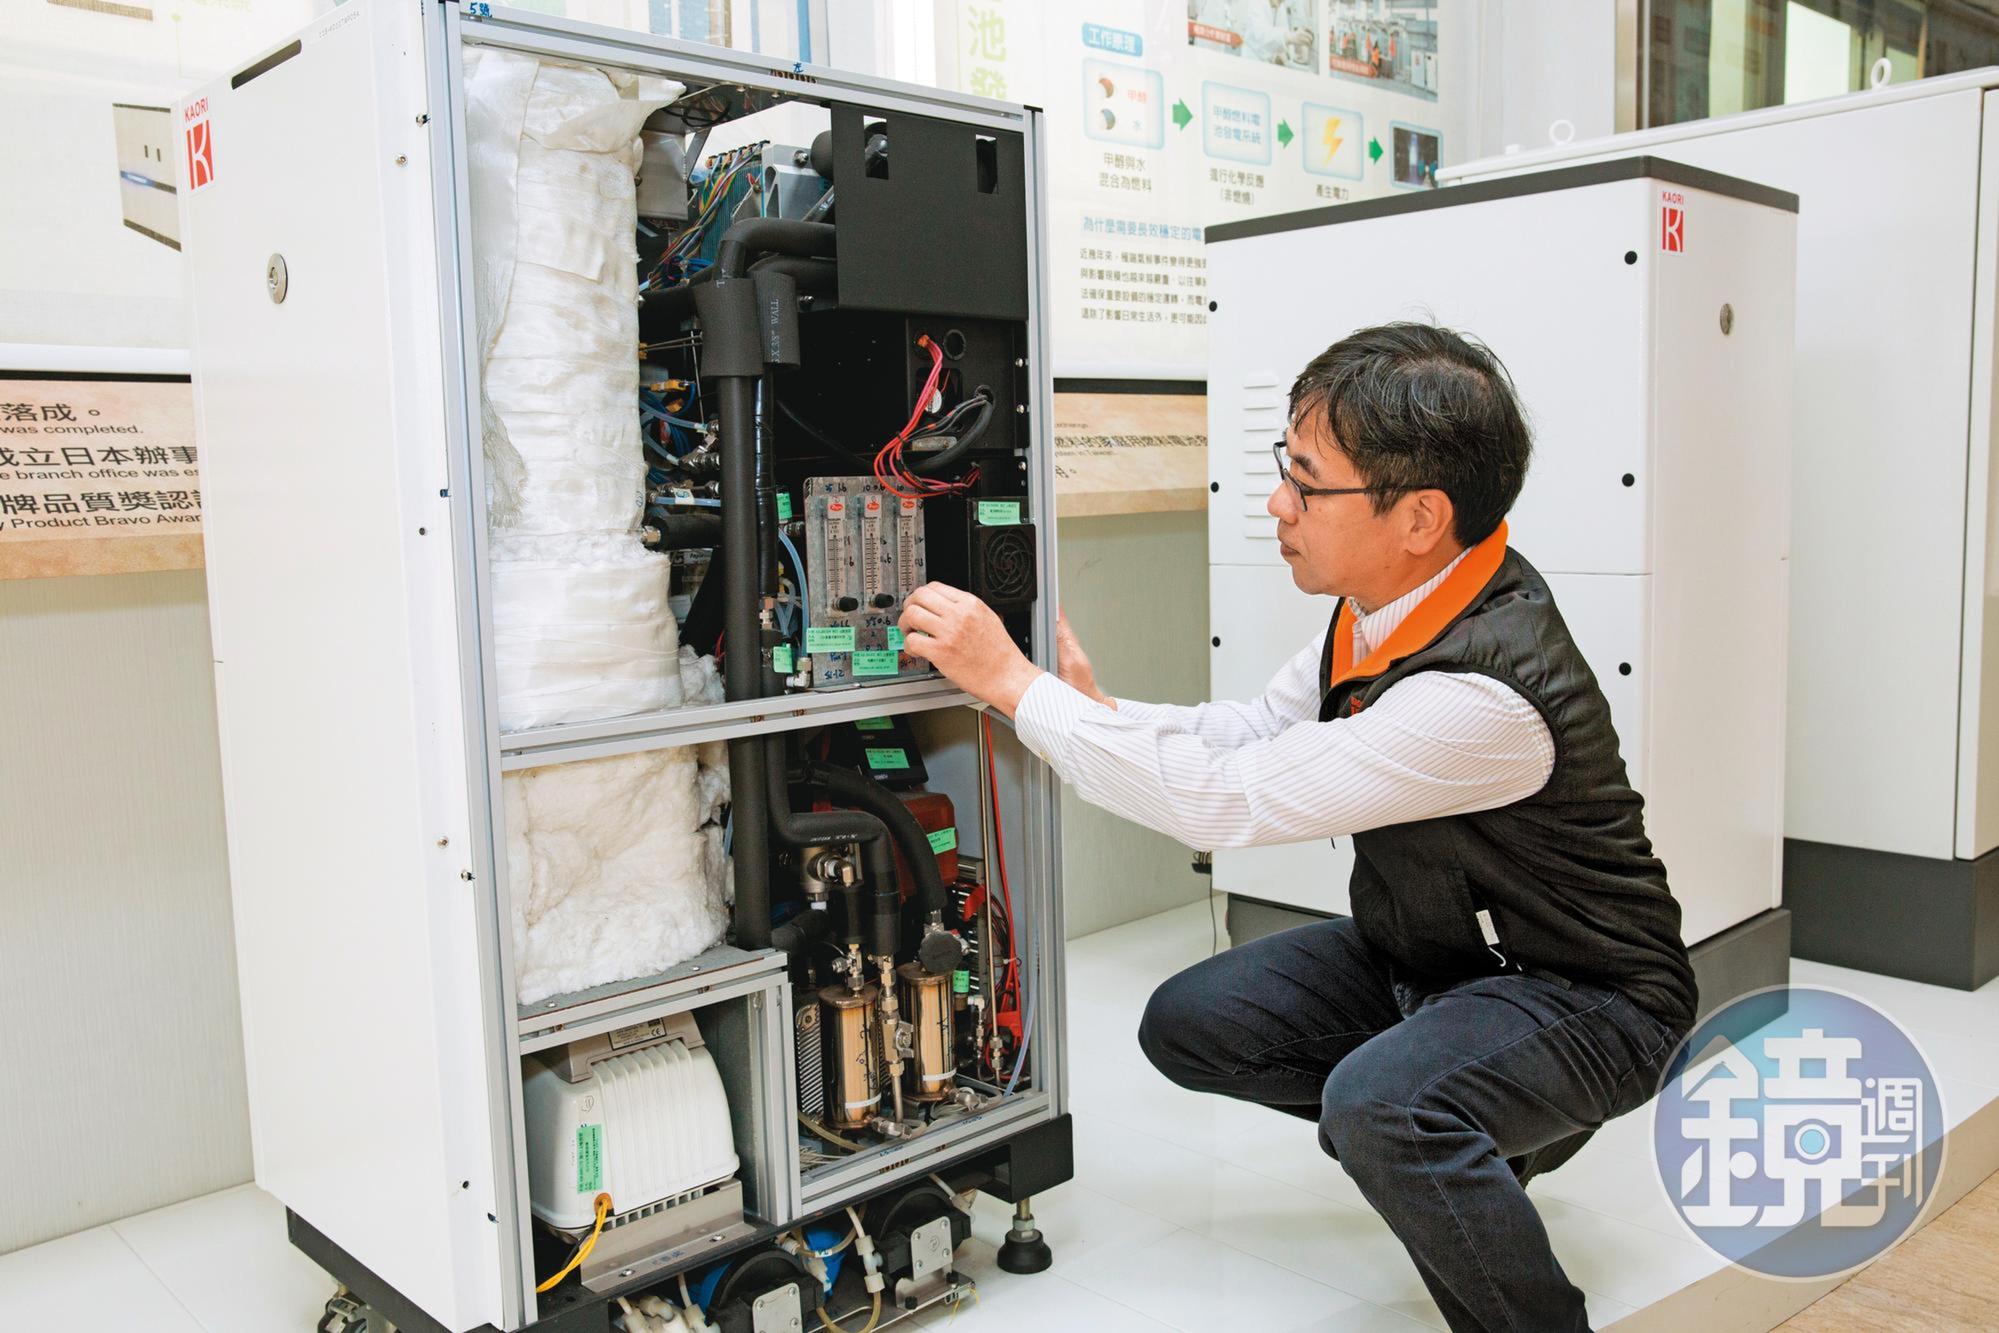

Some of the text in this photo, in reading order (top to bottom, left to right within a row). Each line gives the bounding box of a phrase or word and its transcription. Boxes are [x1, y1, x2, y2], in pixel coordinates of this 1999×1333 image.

[1088, 27, 1137, 53] 工作原理
[184, 97, 208, 121] KAORI
[1103, 152, 1147, 172] 甲醇與水
[1099, 172, 1152, 192] 混合為燃料
[1315, 184, 1349, 200] 產生電力
[1662, 191, 1684, 205] KAORI
[770, 299, 779, 325] WALL
[0, 425, 144, 435] was completed.
[16, 471, 83, 480] branch
[88, 469, 138, 478] office
[11, 517, 91, 528] Product
[95, 515, 151, 525] Bravo
